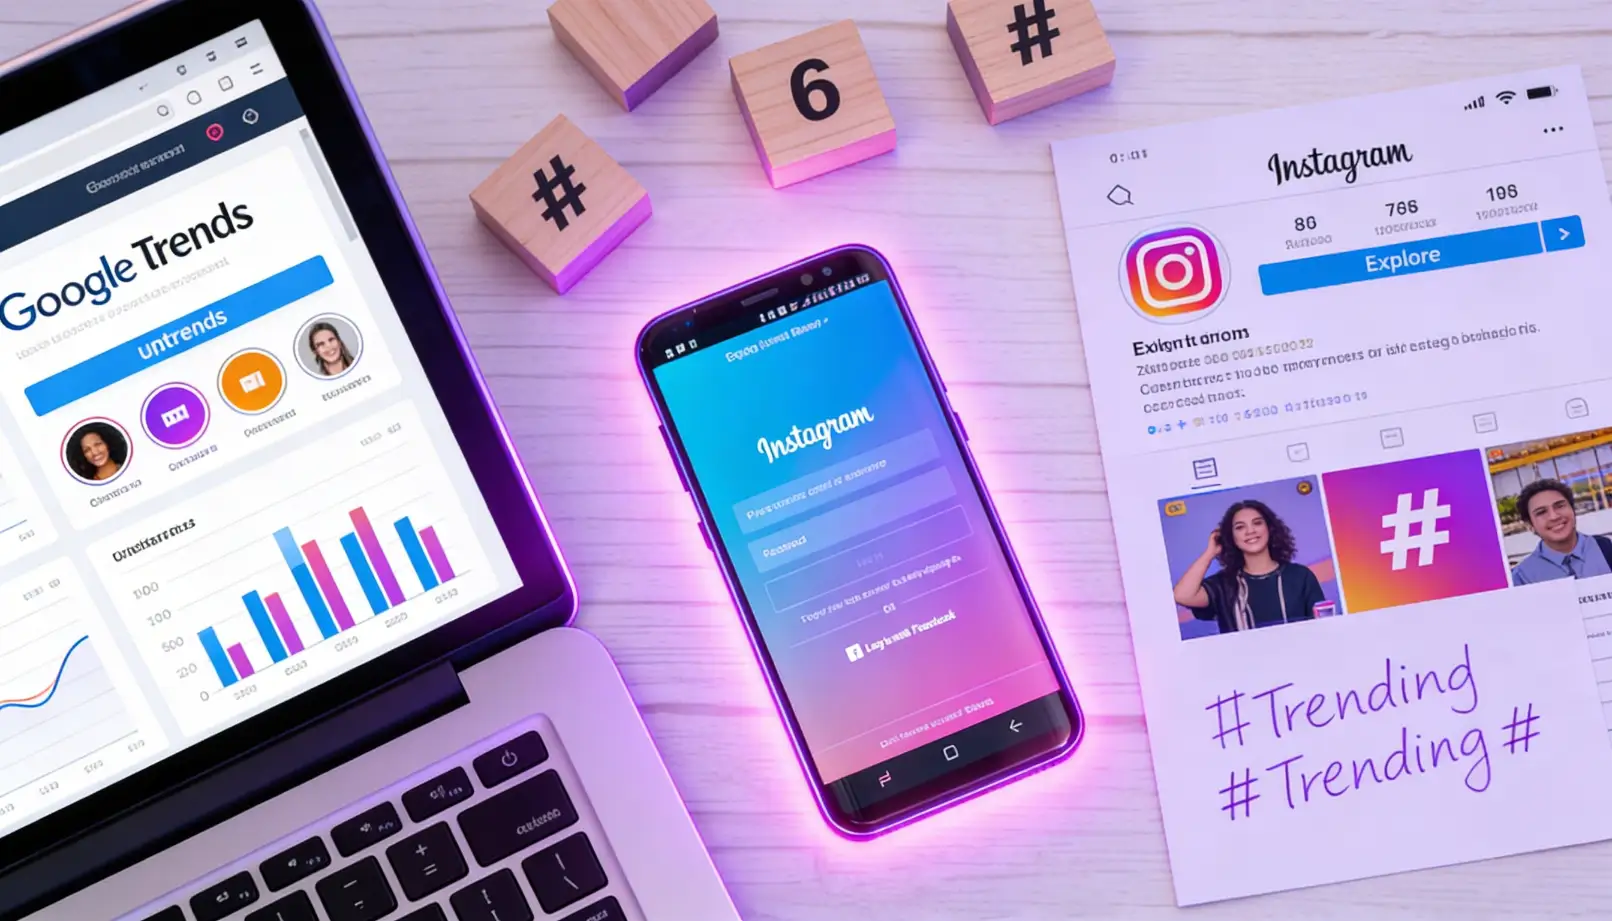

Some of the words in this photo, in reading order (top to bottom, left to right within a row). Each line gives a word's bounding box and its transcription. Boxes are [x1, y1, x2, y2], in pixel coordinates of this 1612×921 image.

[790, 58, 841, 121] 6
[531, 154, 586, 232] #
[1267, 142, 1413, 186] Instagram
[0, 254, 138, 331] Google
[131, 201, 254, 271] Trends
[1364, 249, 1441, 275] Explore
[757, 406, 875, 464] Instagram
[1380, 488, 1451, 571] #
